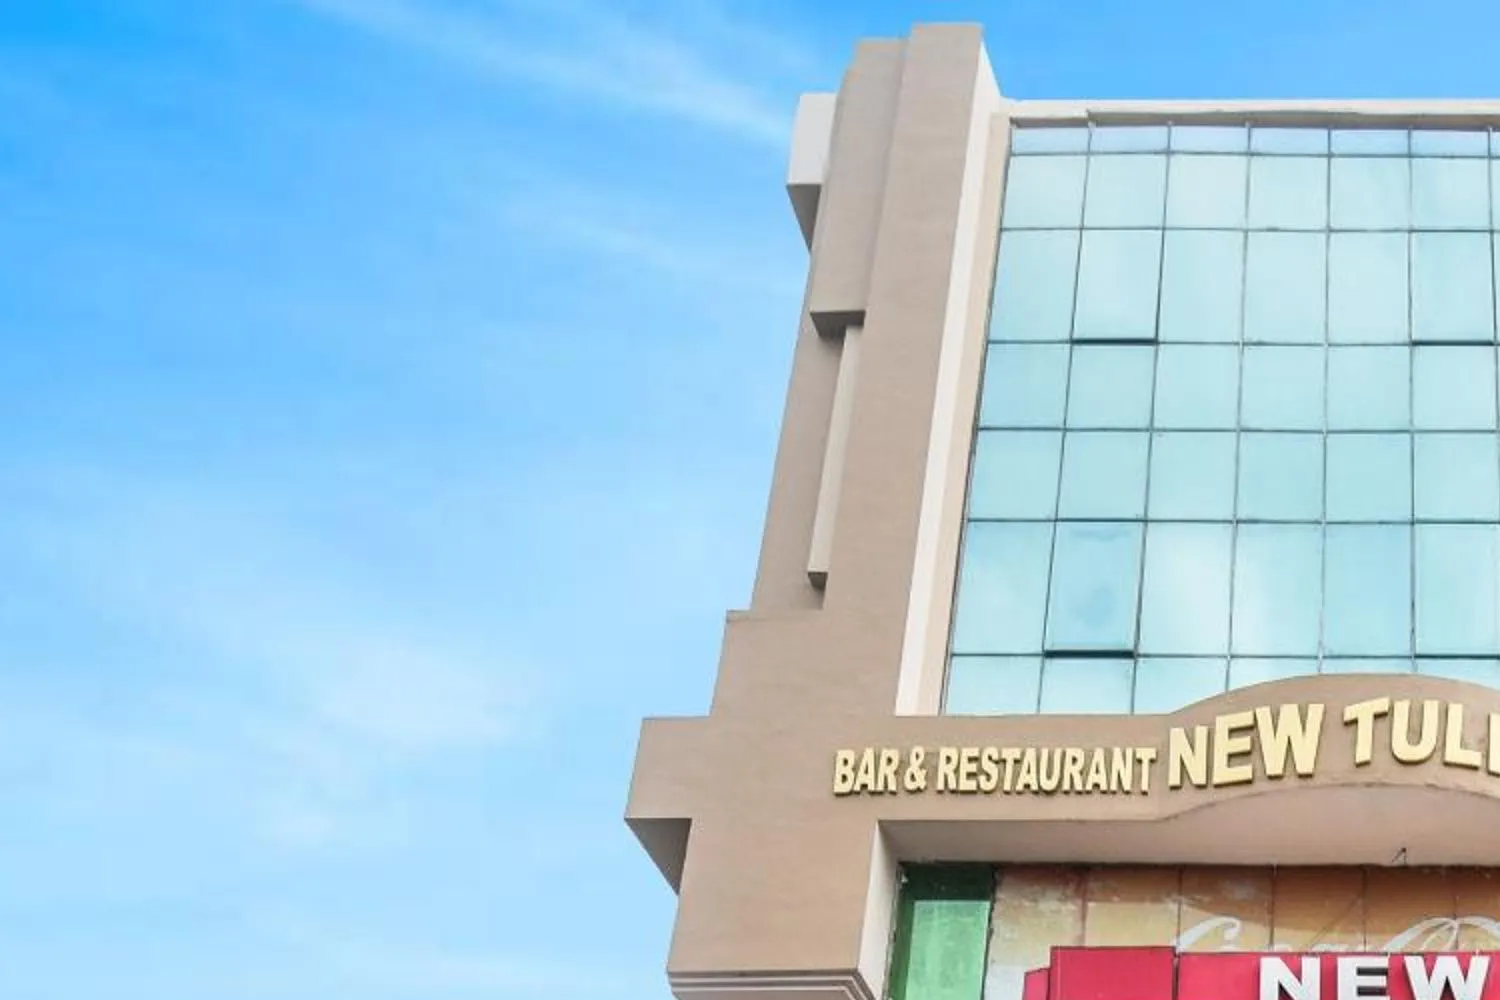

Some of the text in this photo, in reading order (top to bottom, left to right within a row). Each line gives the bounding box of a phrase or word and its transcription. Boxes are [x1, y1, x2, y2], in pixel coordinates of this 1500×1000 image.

[833, 745, 1157, 797] BAR & RESTAURANT
[1166, 702, 1326, 789] NEW
